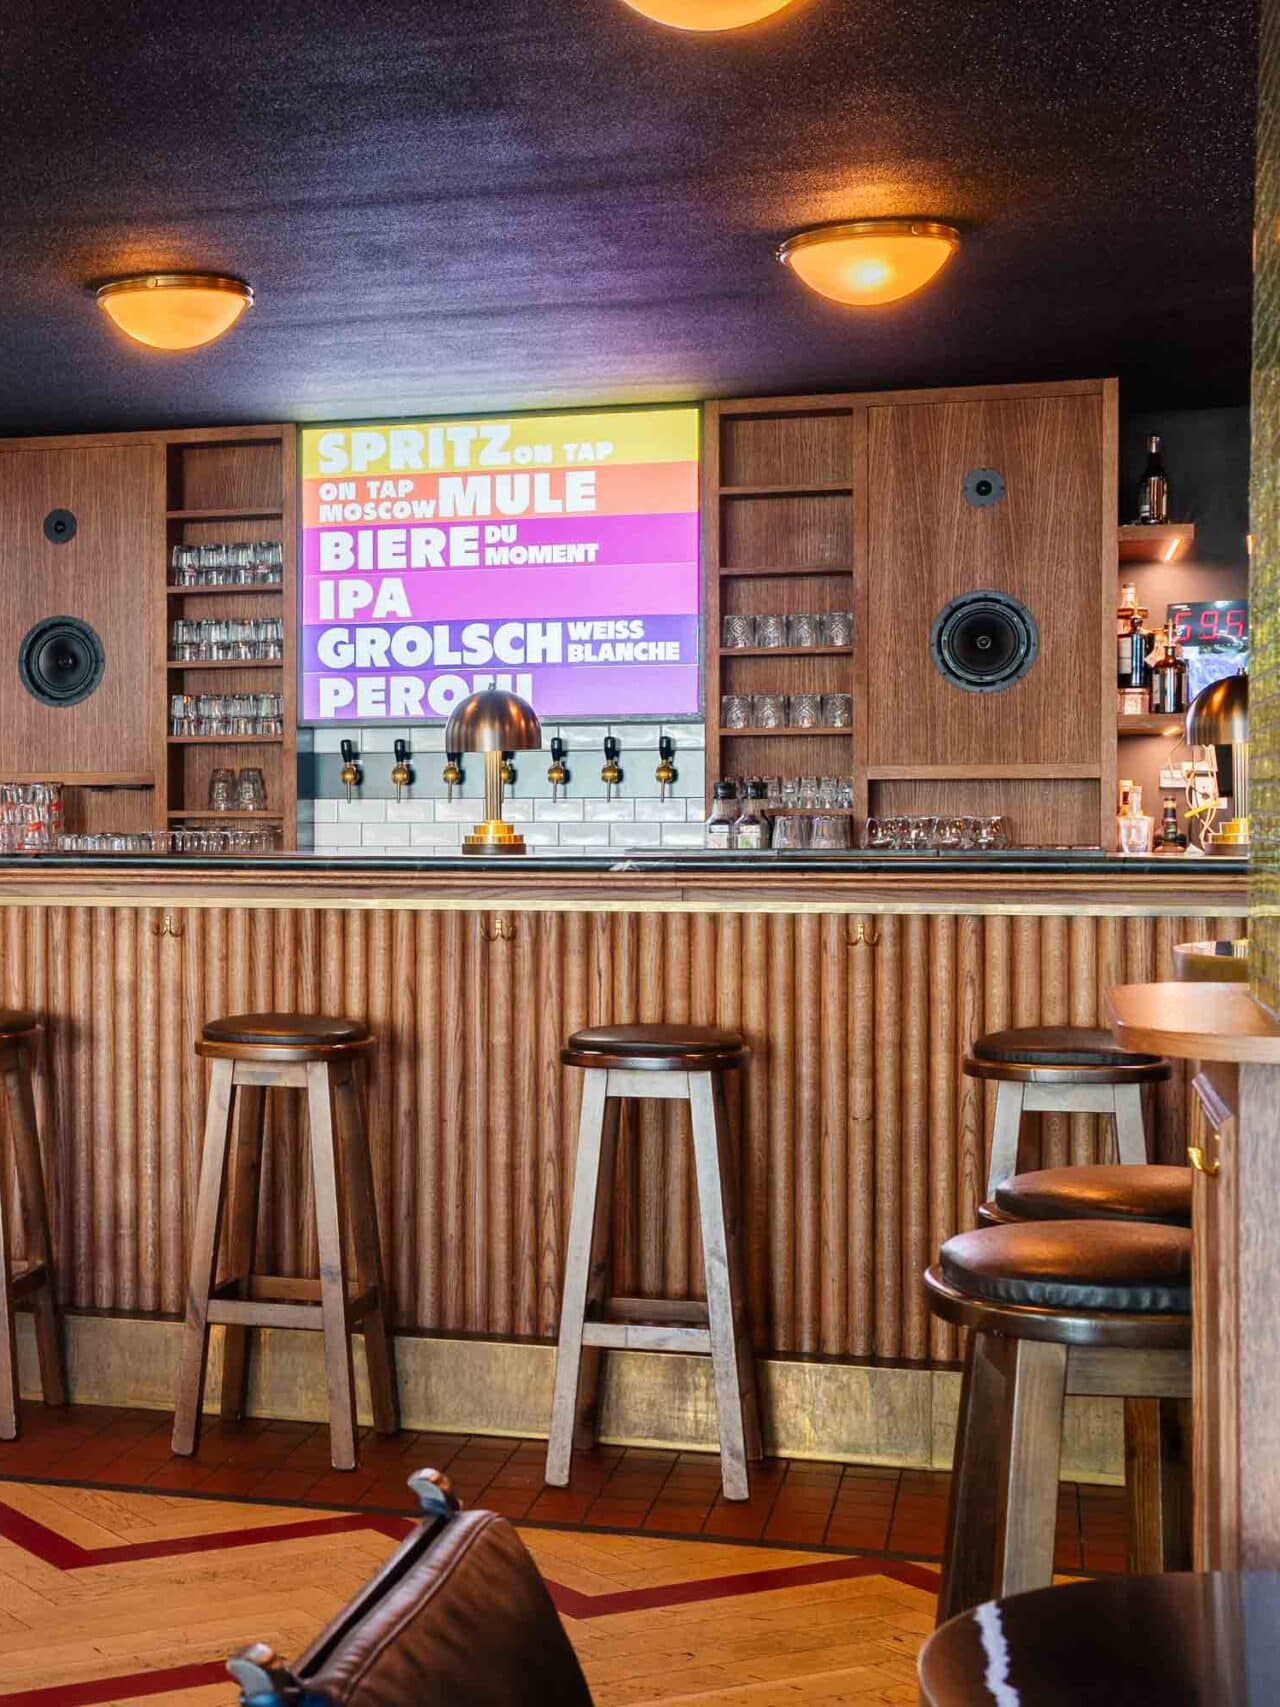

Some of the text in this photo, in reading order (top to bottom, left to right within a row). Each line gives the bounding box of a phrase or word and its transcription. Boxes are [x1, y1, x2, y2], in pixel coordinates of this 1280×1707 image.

[319, 425, 614, 474] SPRITZ ON TAP
[319, 480, 414, 501] ON TAP
[320, 471, 597, 523] MOSCOW MULE
[320, 524, 517, 572] BIERE DU
[485, 543, 599, 566] MOMENT
[320, 577, 412, 619] IPA
[317, 620, 644, 669] GROLSCH WEISS
[570, 641, 680, 662] BLANCHE
